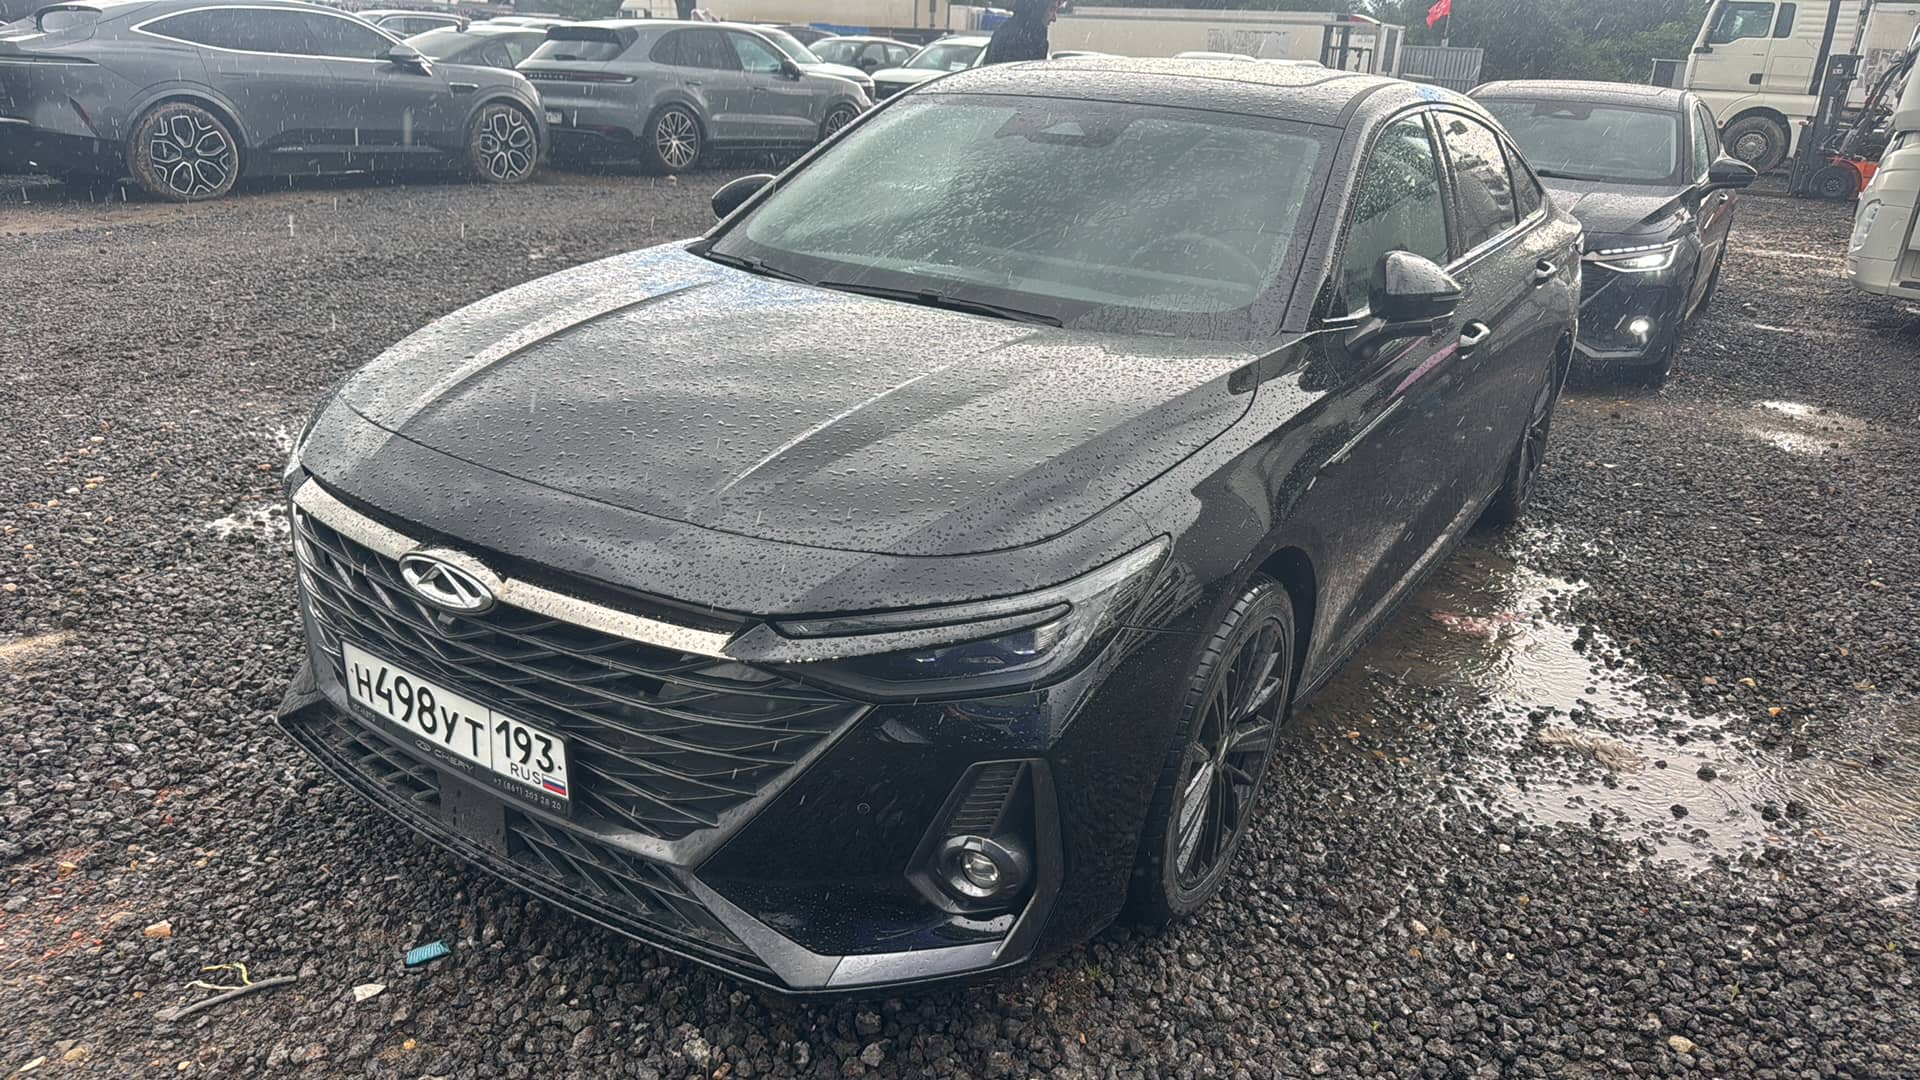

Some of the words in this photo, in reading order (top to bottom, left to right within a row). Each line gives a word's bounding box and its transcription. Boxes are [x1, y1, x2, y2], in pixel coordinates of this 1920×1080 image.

[495, 719, 554, 774] 193
[434, 748, 475, 773] CHERY
[510, 762, 542, 785] RUS
